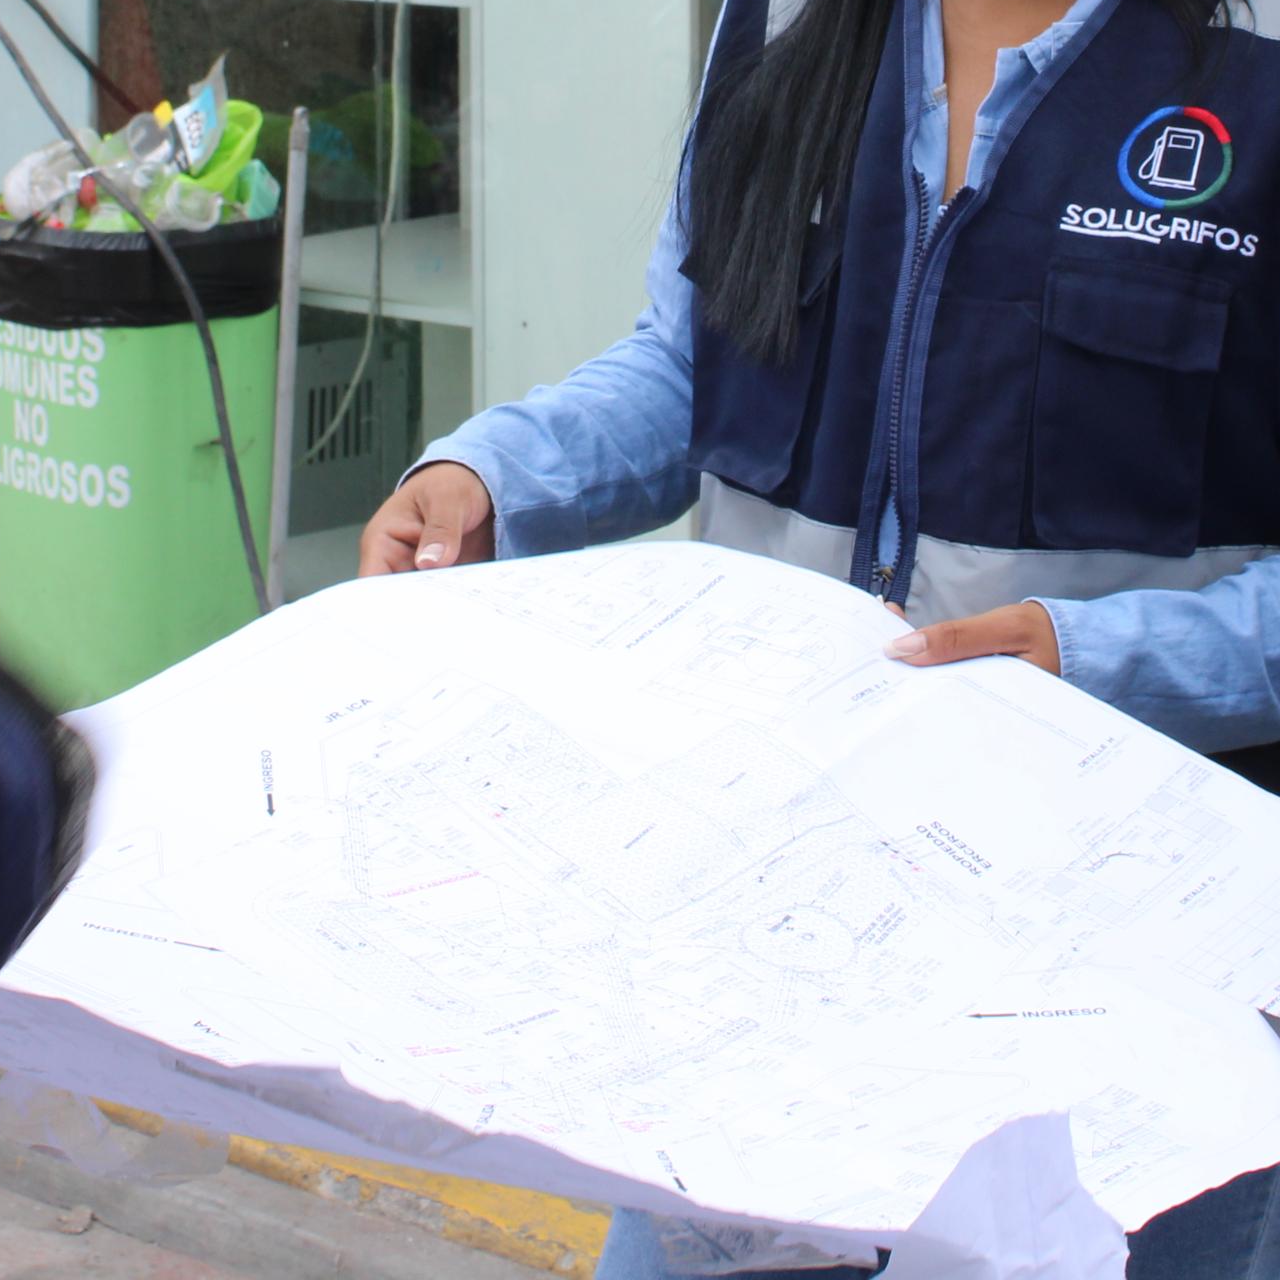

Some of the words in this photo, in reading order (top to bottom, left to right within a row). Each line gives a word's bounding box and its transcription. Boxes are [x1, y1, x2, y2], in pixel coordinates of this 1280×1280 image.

[1061, 204, 1259, 257] SOLUGRIFOS
[14, 398, 49, 447] NO
[346, 696, 373, 714] ICA
[261, 749, 273, 793] INGRESO
[915, 823, 982, 879] ROPIEDAD
[929, 820, 993, 870] ERCEROS
[83, 922, 169, 943] INGRESO
[1022, 1006, 1107, 1019] INGRESO
